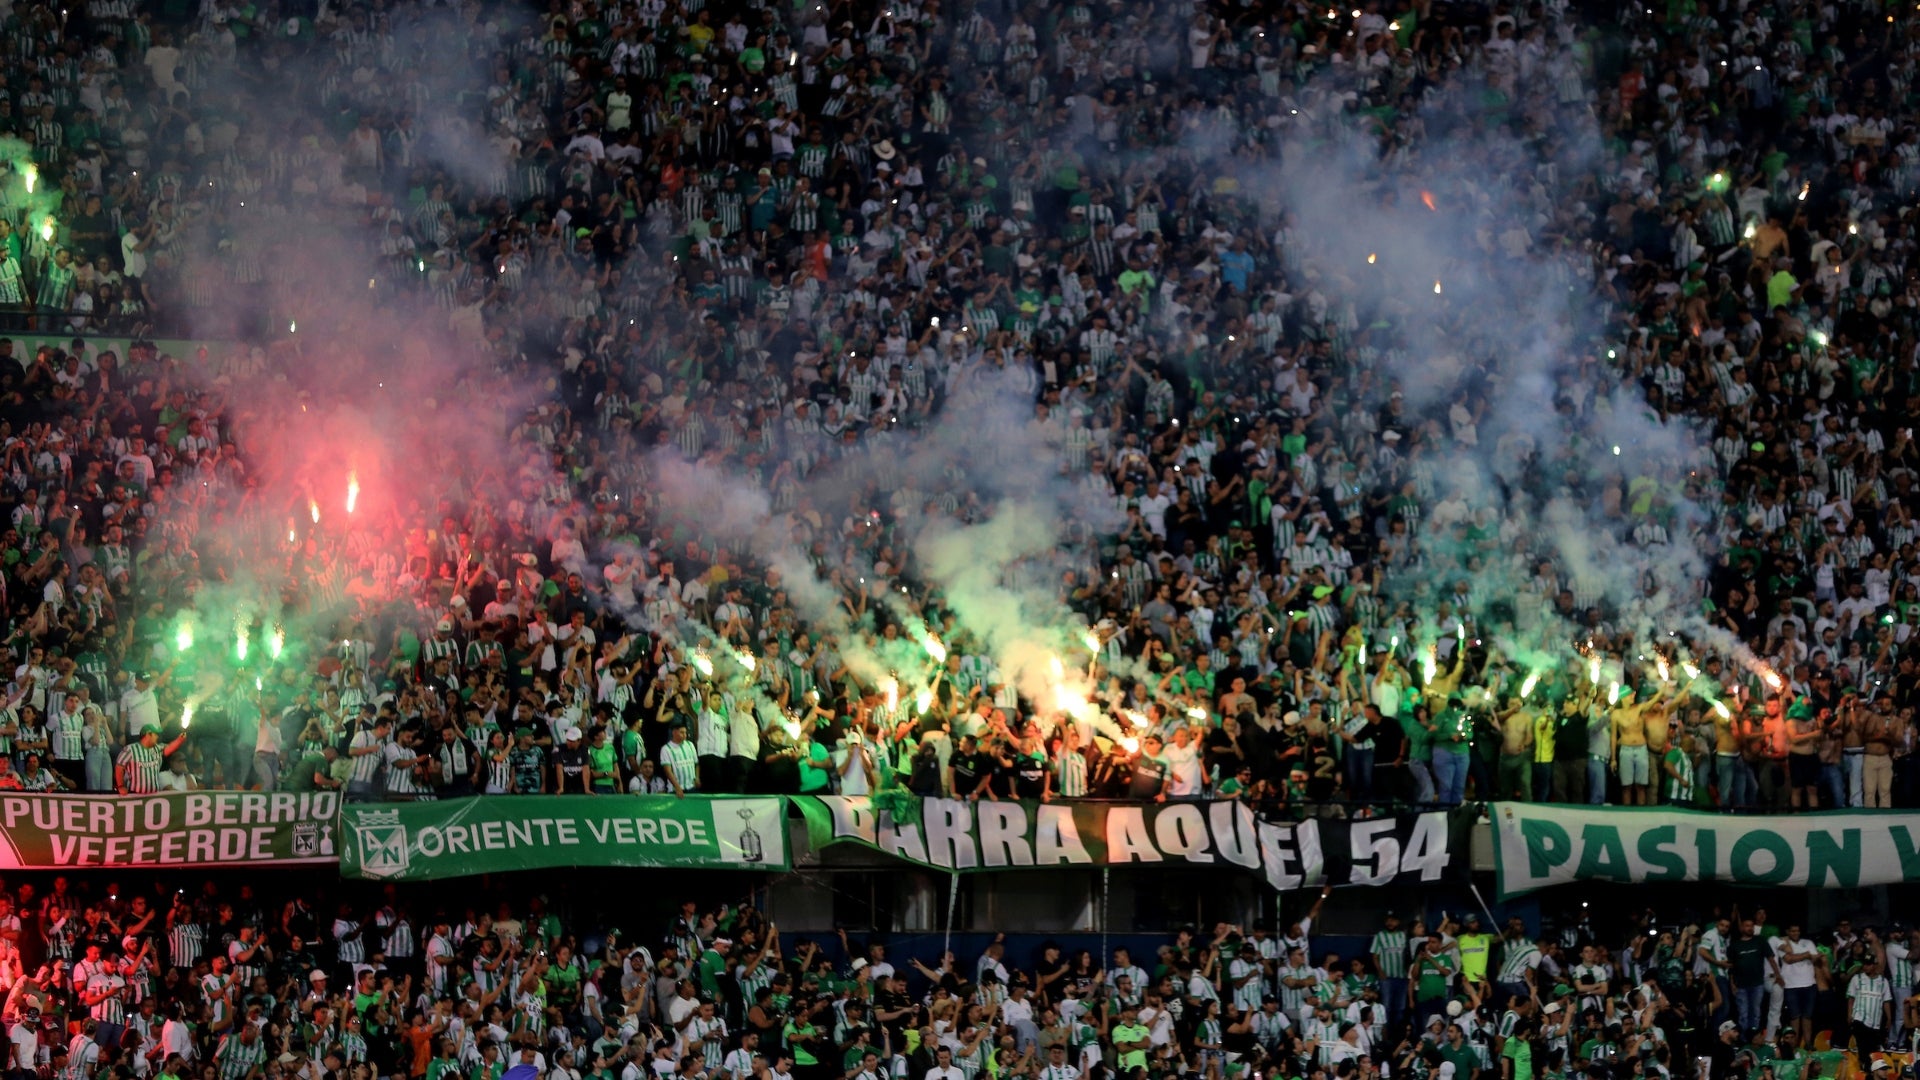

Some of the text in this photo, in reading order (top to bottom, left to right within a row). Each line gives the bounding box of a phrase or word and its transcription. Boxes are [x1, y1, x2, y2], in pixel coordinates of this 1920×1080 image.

[4, 791, 337, 832] PUERTO BERRIO
[418, 817, 709, 857] ORIENTE VERDE
[816, 795, 1450, 890] BARRA AQUEL 54
[1521, 818, 1861, 888] PASION
